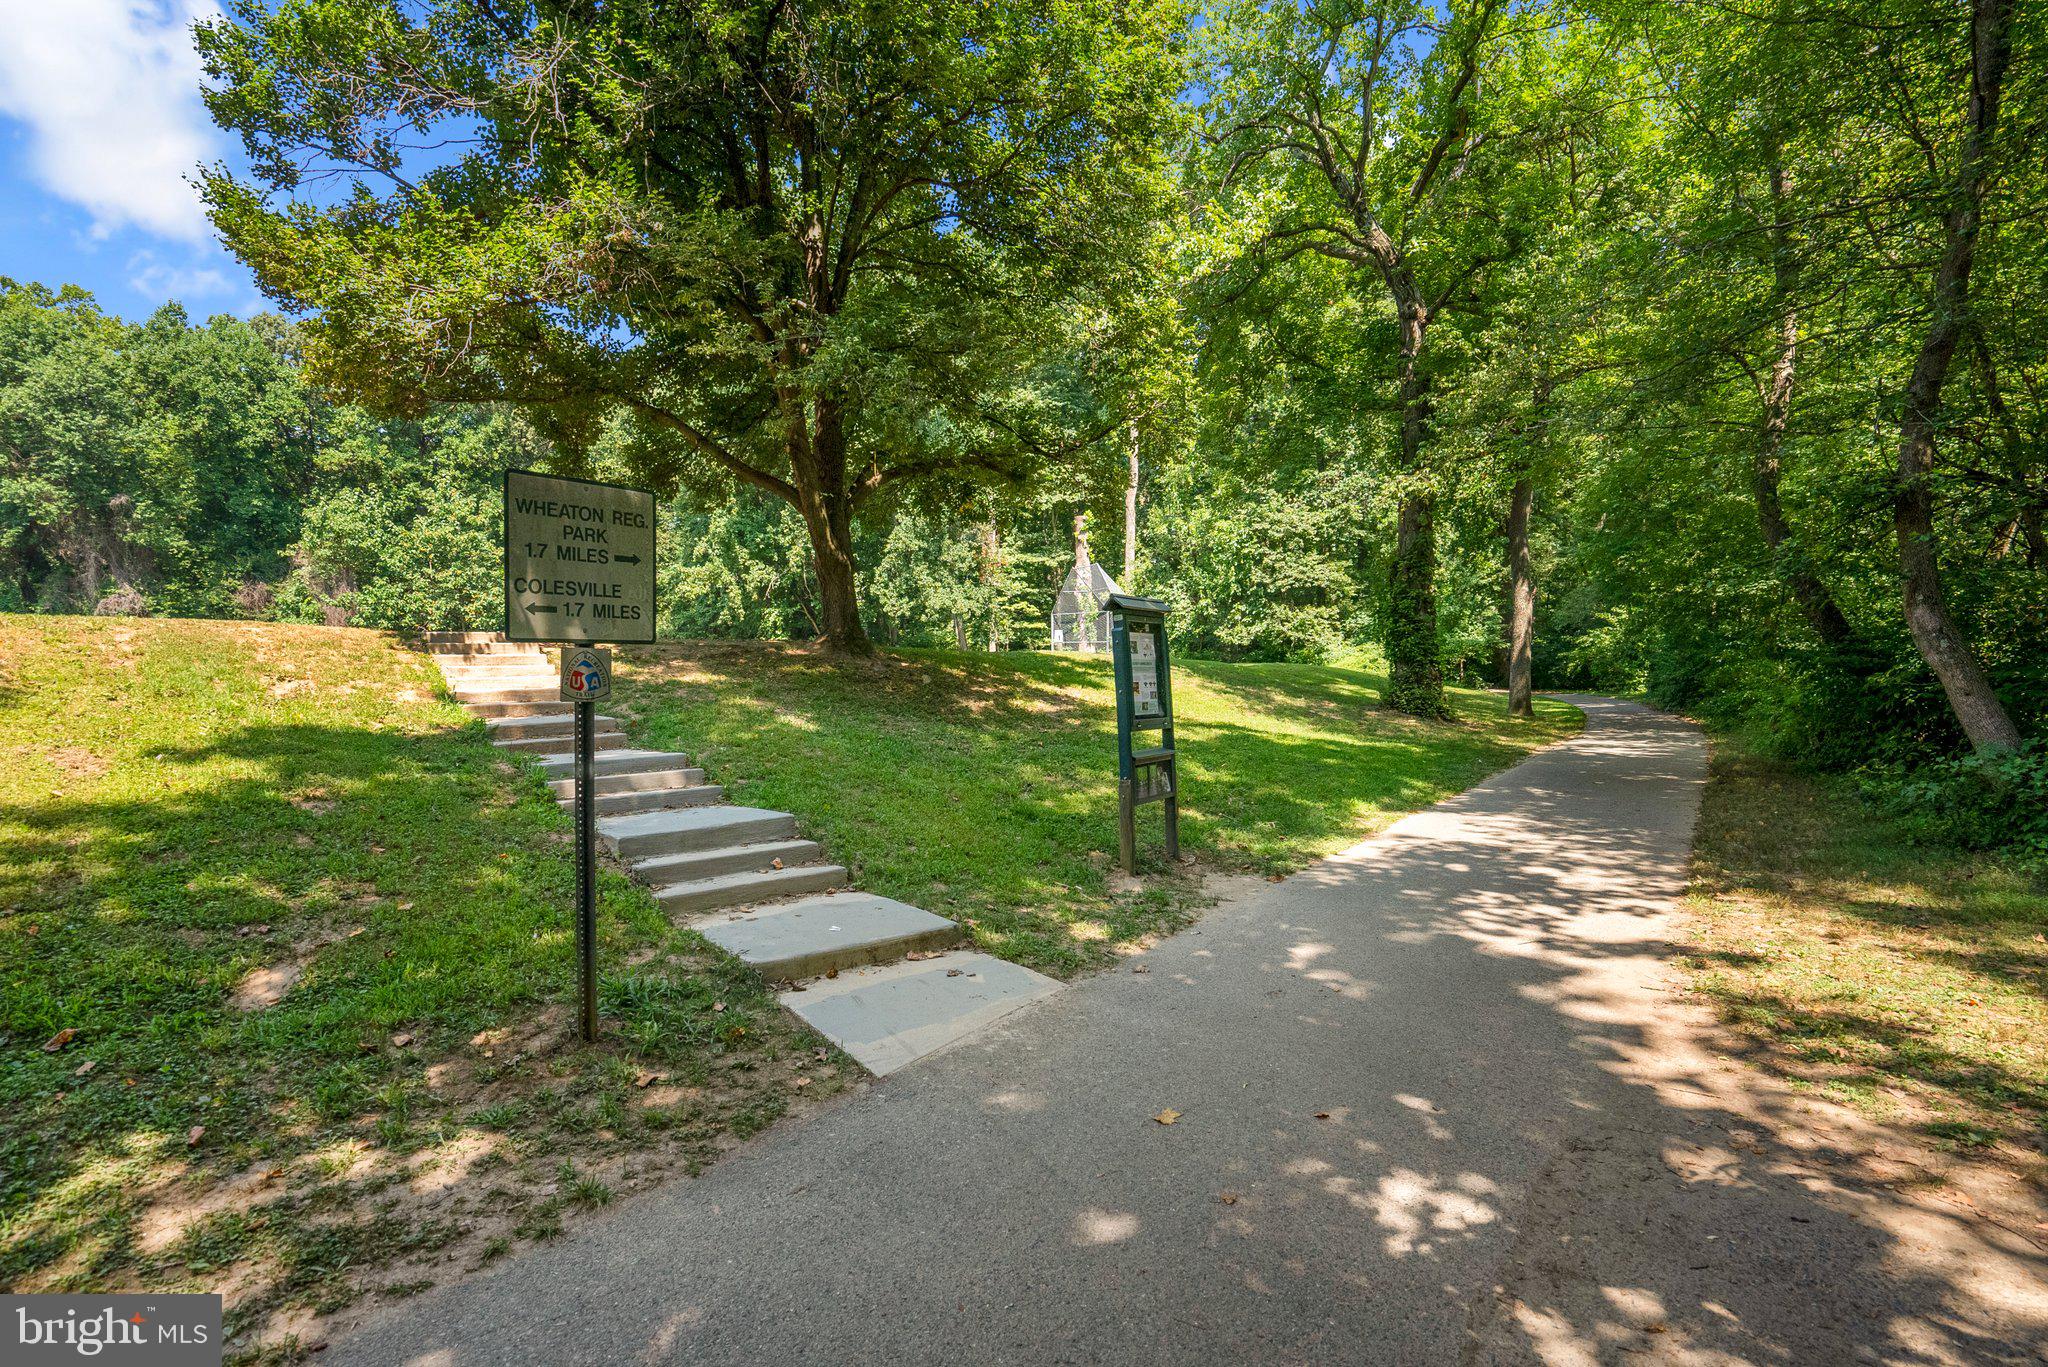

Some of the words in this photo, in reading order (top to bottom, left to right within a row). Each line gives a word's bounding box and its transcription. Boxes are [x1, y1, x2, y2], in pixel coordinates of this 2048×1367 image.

[515, 498, 604, 523] WHEATON
[612, 510, 648, 529] REG.
[563, 525, 608, 543] PARK
[524, 542, 548, 559] 1.7
[556, 545, 609, 564] MILES
[513, 577, 622, 599] COLESVILLE
[563, 602, 585, 618] 1.7
[592, 603, 641, 620] MILES
[572, 673, 600, 690] USA
